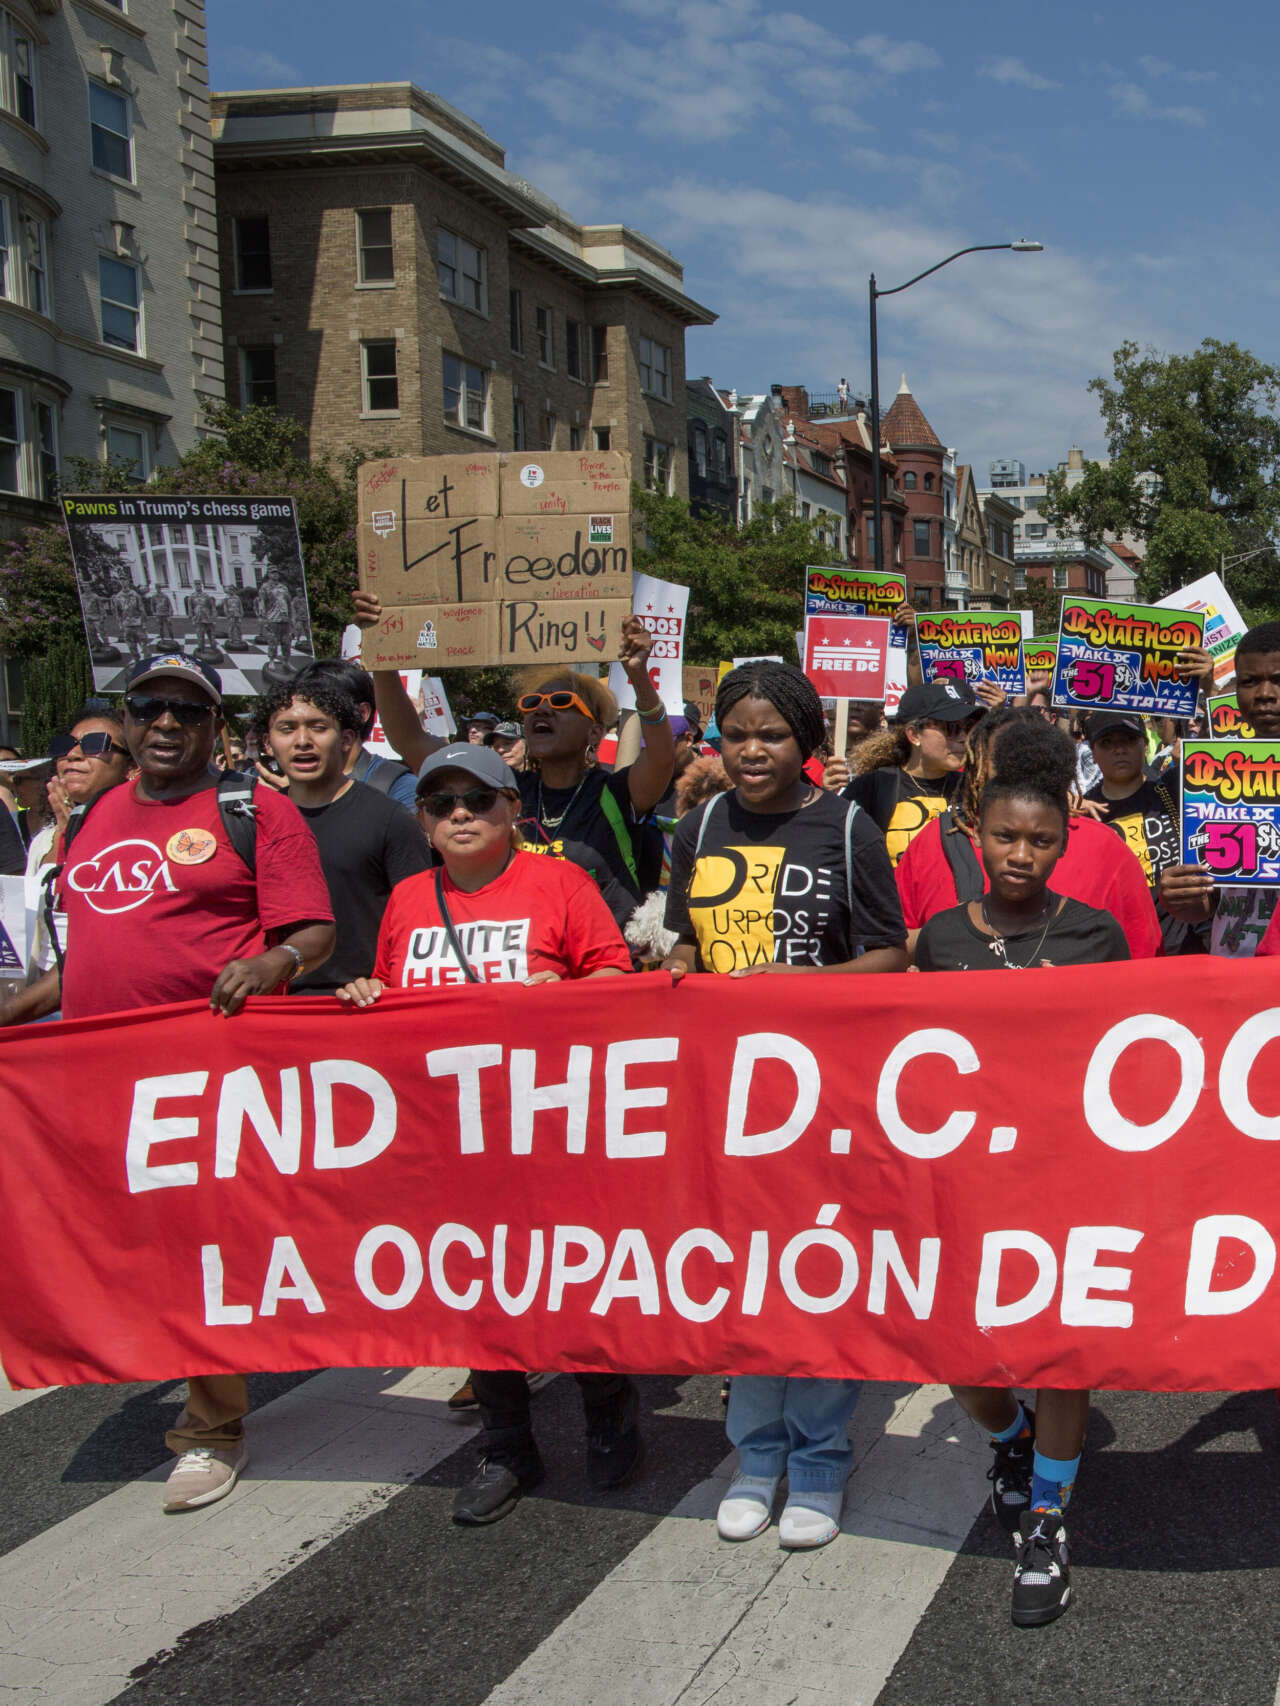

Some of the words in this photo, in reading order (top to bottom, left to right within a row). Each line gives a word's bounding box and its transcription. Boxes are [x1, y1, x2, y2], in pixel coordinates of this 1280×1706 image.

[65, 500, 117, 515] Pawns
[120, 501, 135, 515] in
[137, 500, 200, 519] Trump's
[203, 502, 247, 516] chess
[250, 504, 291, 520] game
[402, 475, 454, 572] Let
[590, 526, 612, 534] LIVES
[449, 518, 627, 603] Freedom
[919, 620, 941, 641] DC
[1064, 606, 1094, 634] DC
[812, 659, 853, 671] FREE
[856, 661, 879, 672] DC
[985, 645, 1018, 673] NOW
[1071, 646, 1111, 661] MAKE
[1113, 693, 1176, 710] STATE
[1186, 752, 1223, 786] DC
[1199, 803, 1250, 820] MAKE
[1190, 833, 1210, 848] THE
[67, 860, 180, 892] CASA
[125, 1059, 398, 1194] END
[426, 1037, 680, 1159] THE
[724, 1028, 1018, 1159] D.C.
[200, 1236, 326, 1326] LA
[354, 1203, 941, 1323] OCUPACIÓN
[975, 1225, 1145, 1329] DE
